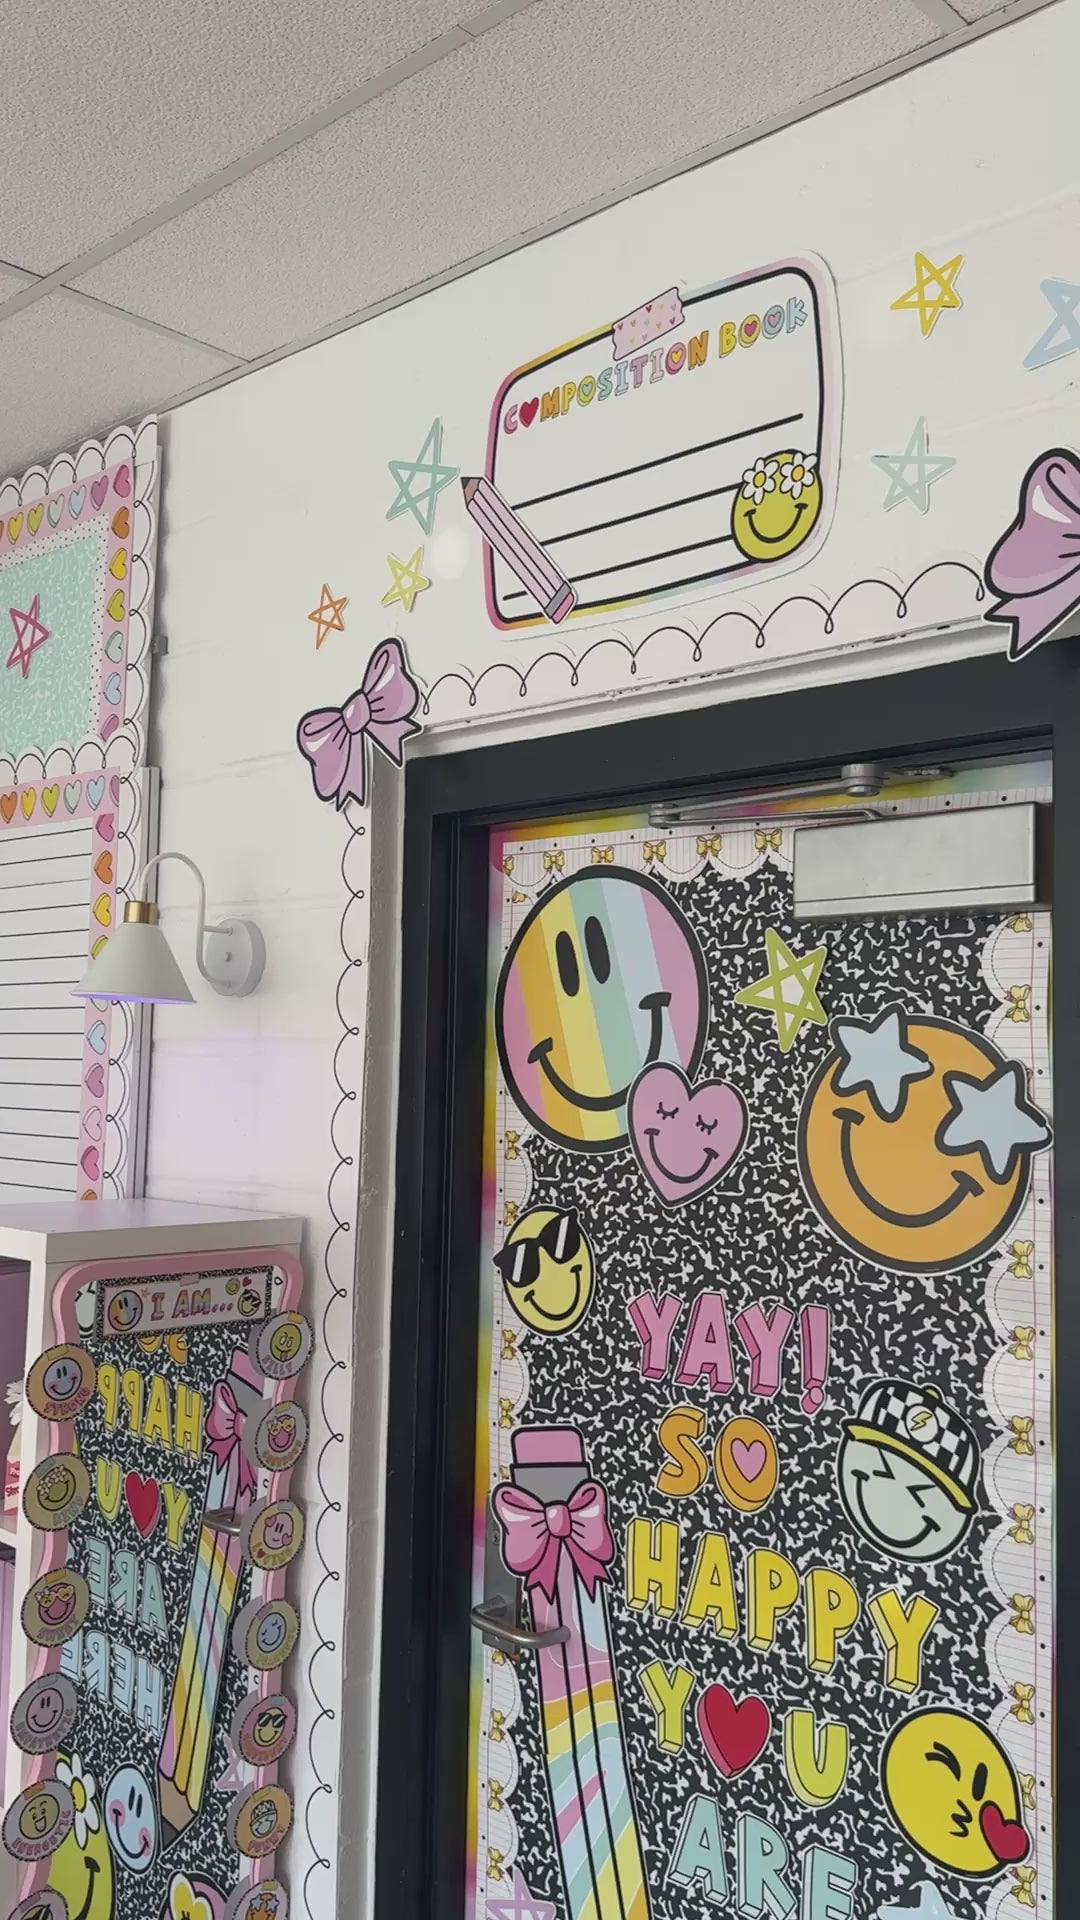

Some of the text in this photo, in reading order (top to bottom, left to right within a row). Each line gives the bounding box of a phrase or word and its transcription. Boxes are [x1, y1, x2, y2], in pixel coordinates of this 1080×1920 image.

[718, 297, 808, 358] BOOK
[150, 1291, 165, 1321] I
[627, 1290, 831, 1415] YAY!
[656, 1405, 779, 1513] SO
[626, 1517, 939, 1694] HAPPY
[668, 1793, 858, 1920] ARE
